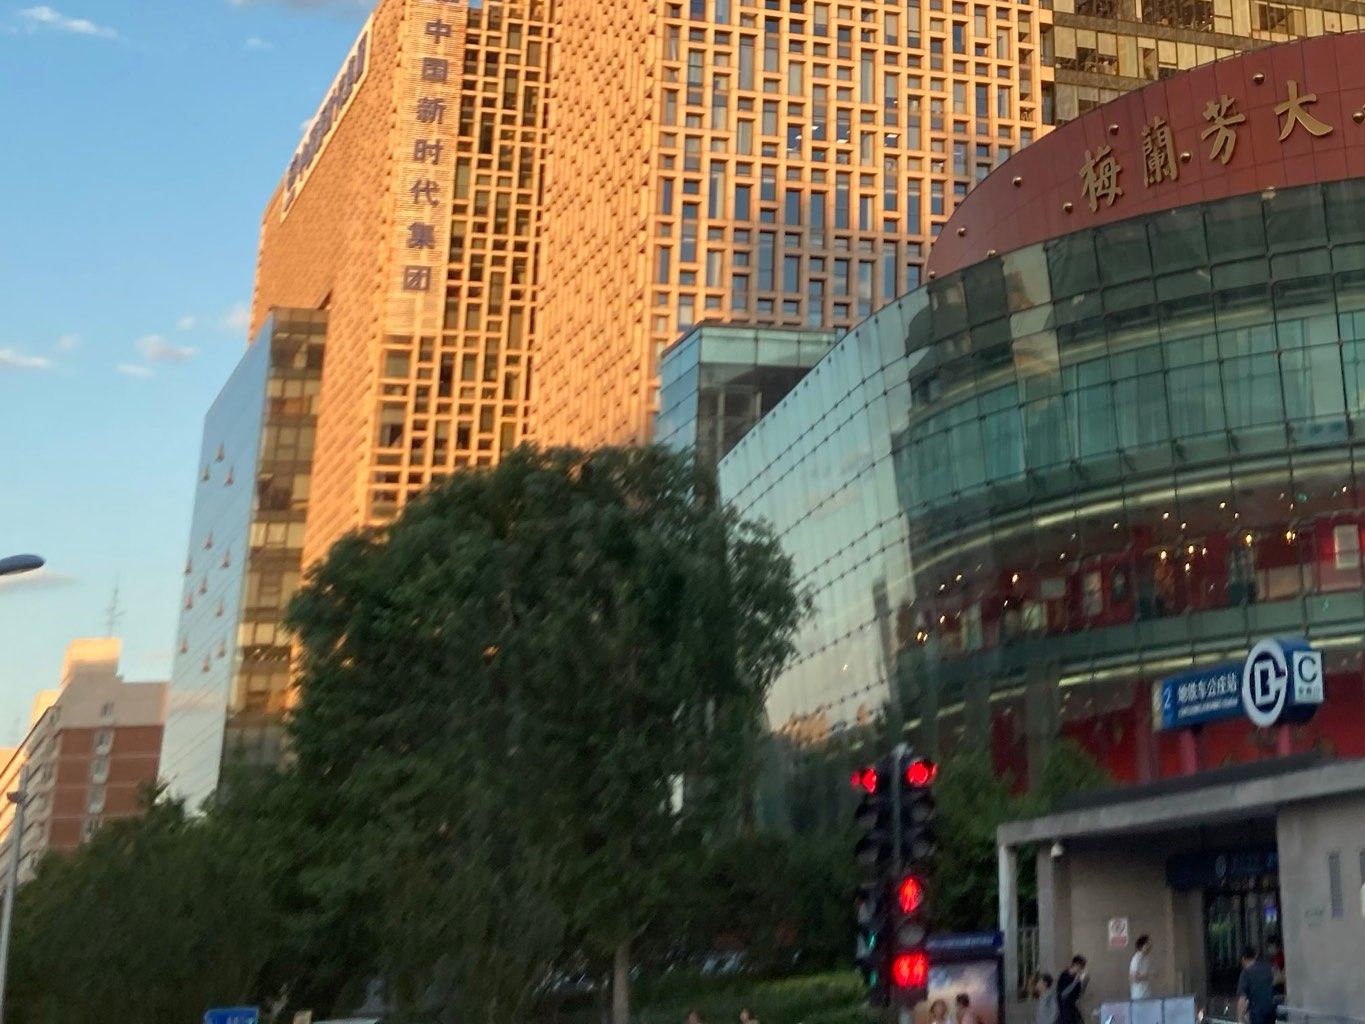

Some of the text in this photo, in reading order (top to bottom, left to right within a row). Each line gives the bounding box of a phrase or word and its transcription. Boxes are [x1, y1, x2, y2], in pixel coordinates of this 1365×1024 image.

[402, 18, 451, 292] 中国新时代集团
[1298, 656, 1317, 682] C
